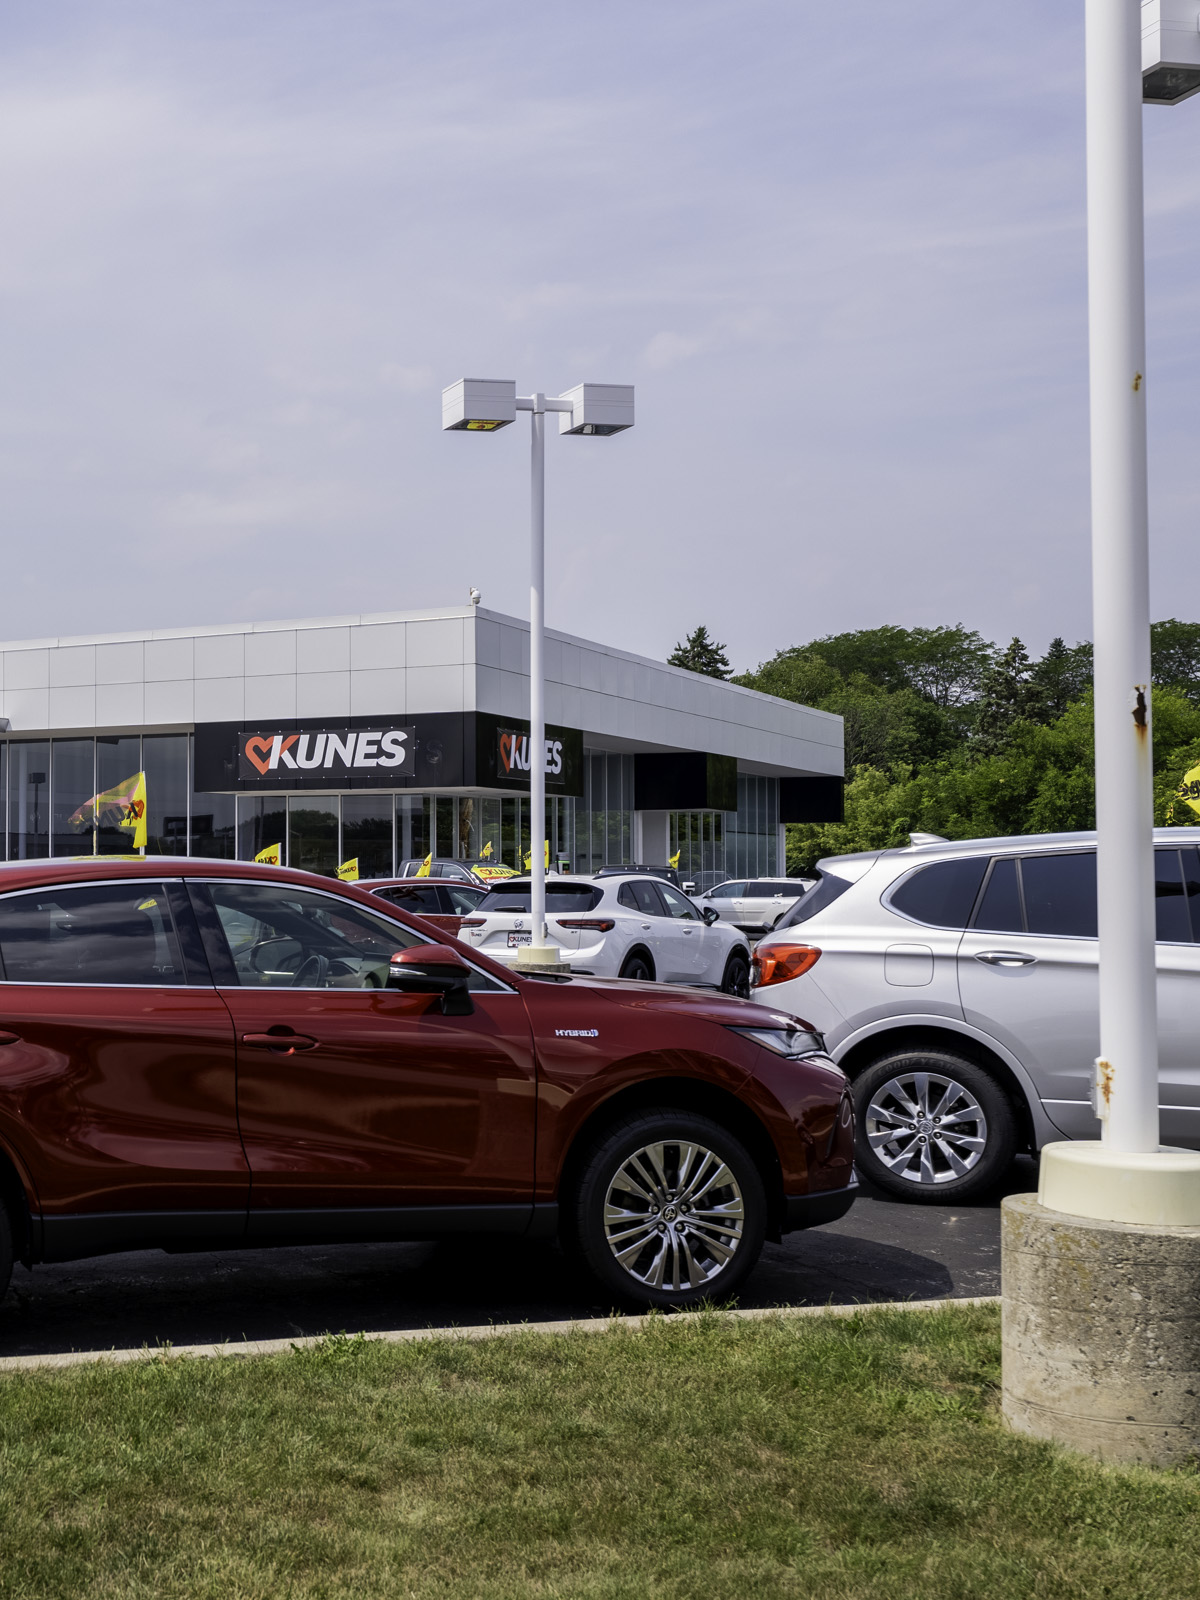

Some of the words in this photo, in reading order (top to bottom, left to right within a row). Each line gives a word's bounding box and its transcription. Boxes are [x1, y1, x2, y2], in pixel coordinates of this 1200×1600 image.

[268, 731, 408, 769] KUNES
[510, 734, 563, 775] KUES
[555, 1029, 592, 1037] HYBRID
